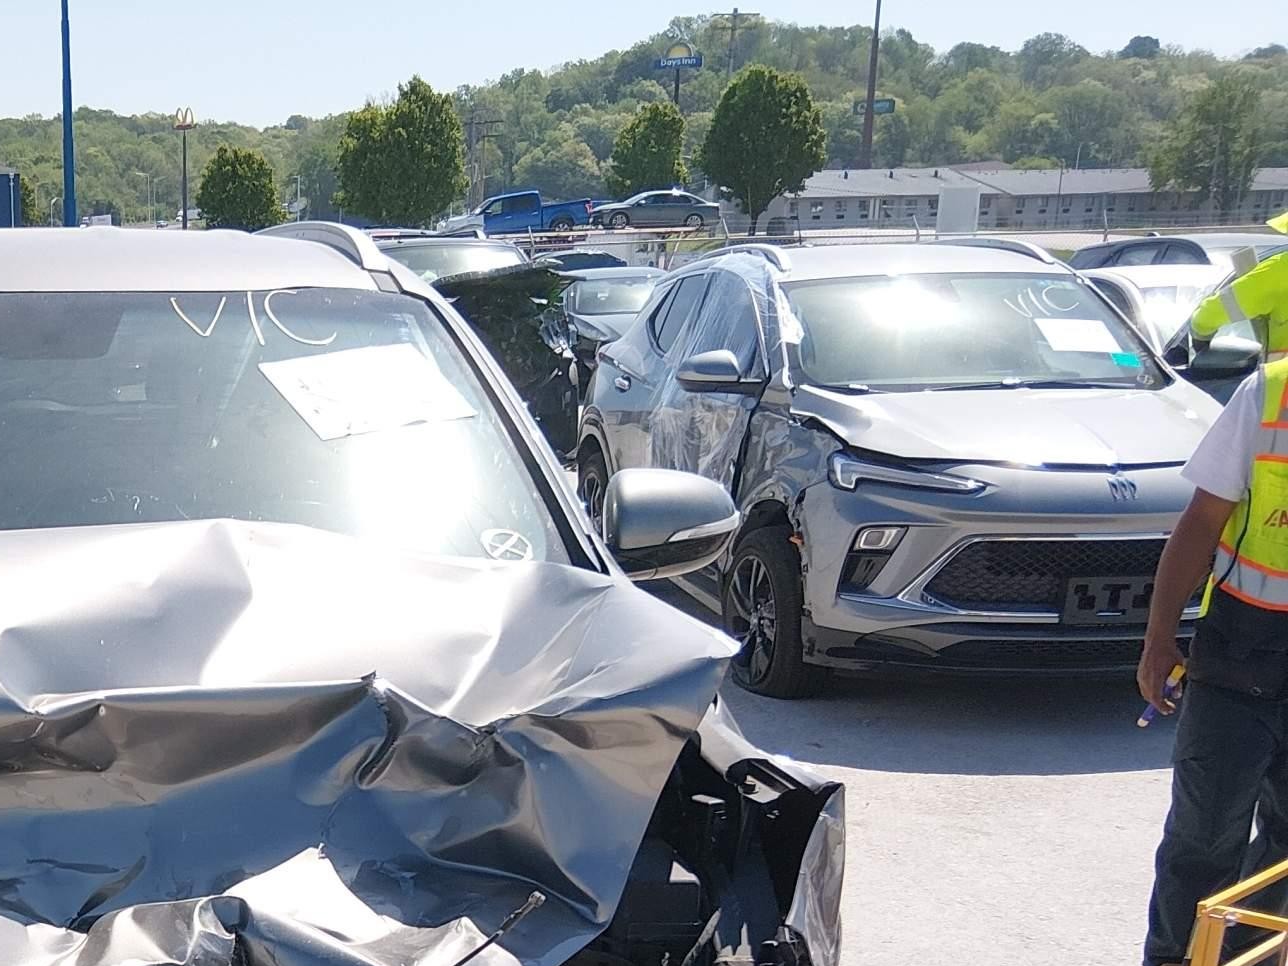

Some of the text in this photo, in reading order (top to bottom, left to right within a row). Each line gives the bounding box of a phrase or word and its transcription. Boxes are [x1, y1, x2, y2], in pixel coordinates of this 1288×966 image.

[660, 58, 681, 67] Days
[170, 290, 337, 346] VIC
[1003, 284, 1080, 318] VIC
